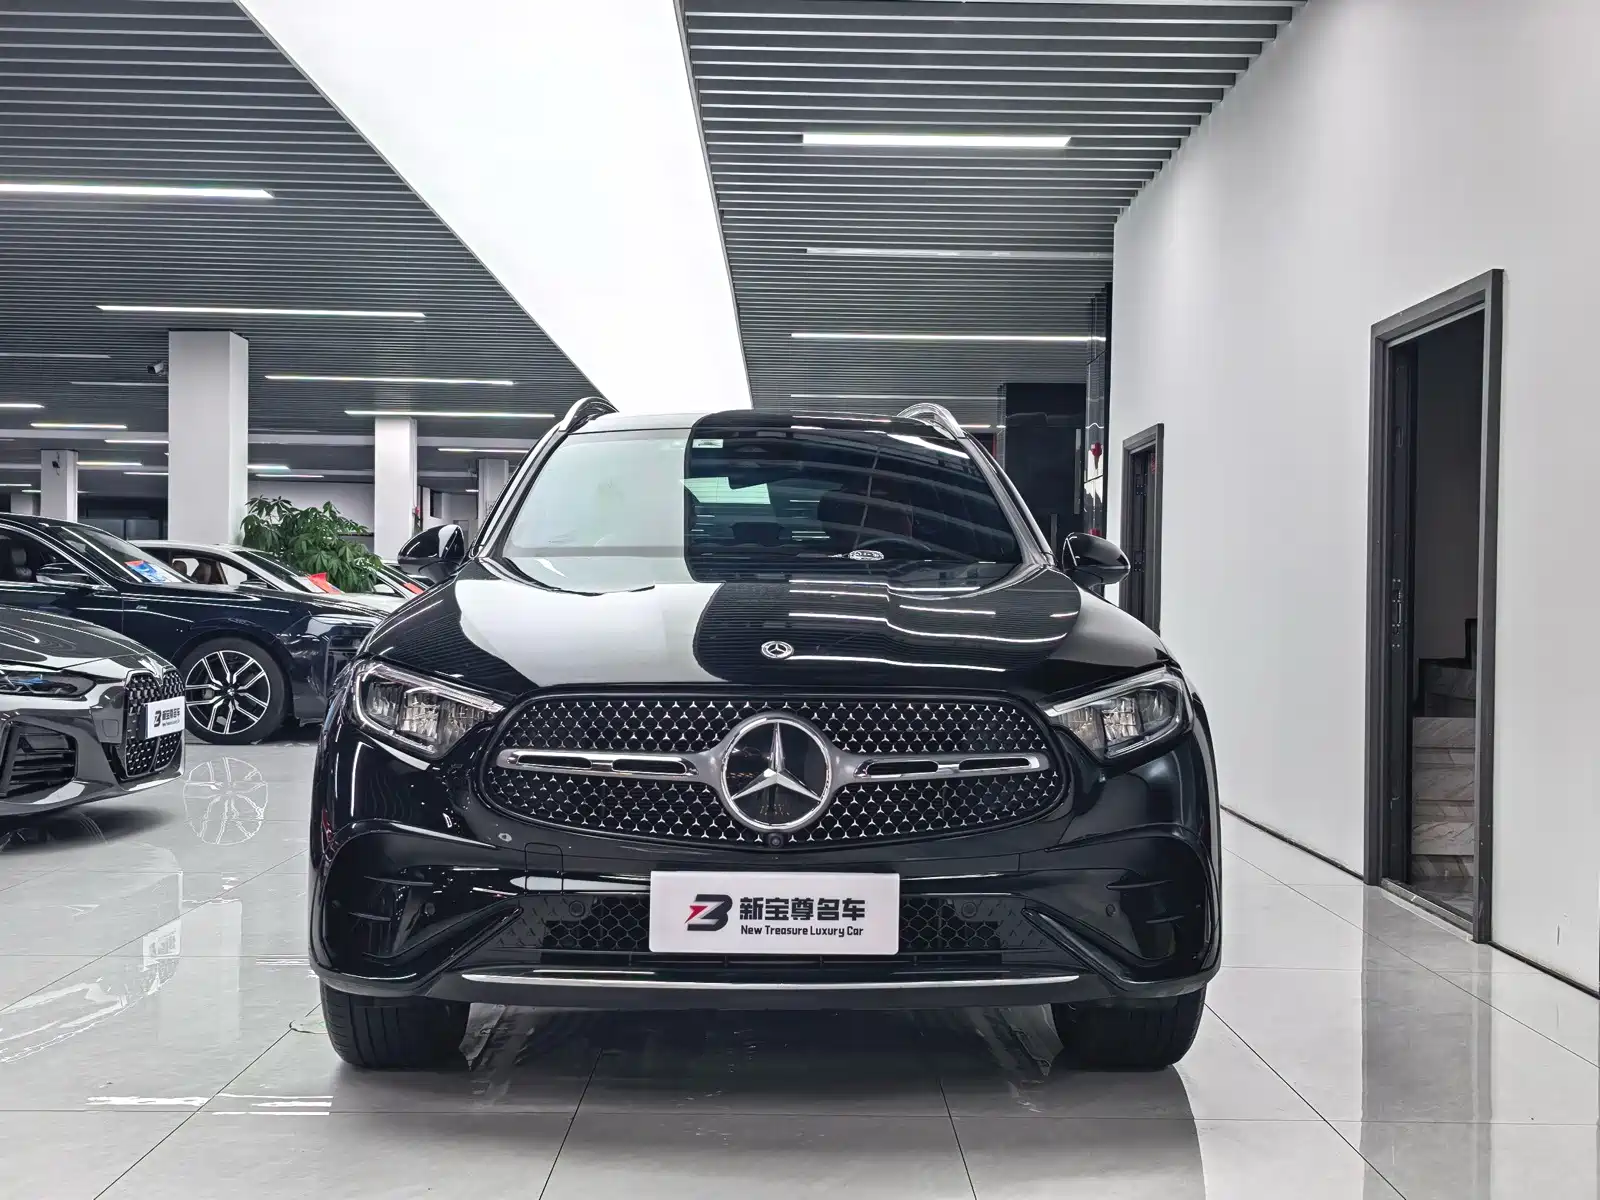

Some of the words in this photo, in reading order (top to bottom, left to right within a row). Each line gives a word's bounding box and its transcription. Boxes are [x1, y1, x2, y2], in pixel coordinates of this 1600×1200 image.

[739, 897, 866, 921] 新宝尊名车
[740, 925, 762, 935] New
[765, 925, 808, 935] Treasure
[810, 926, 844, 937] Luxury
[847, 926, 864, 935] Car
